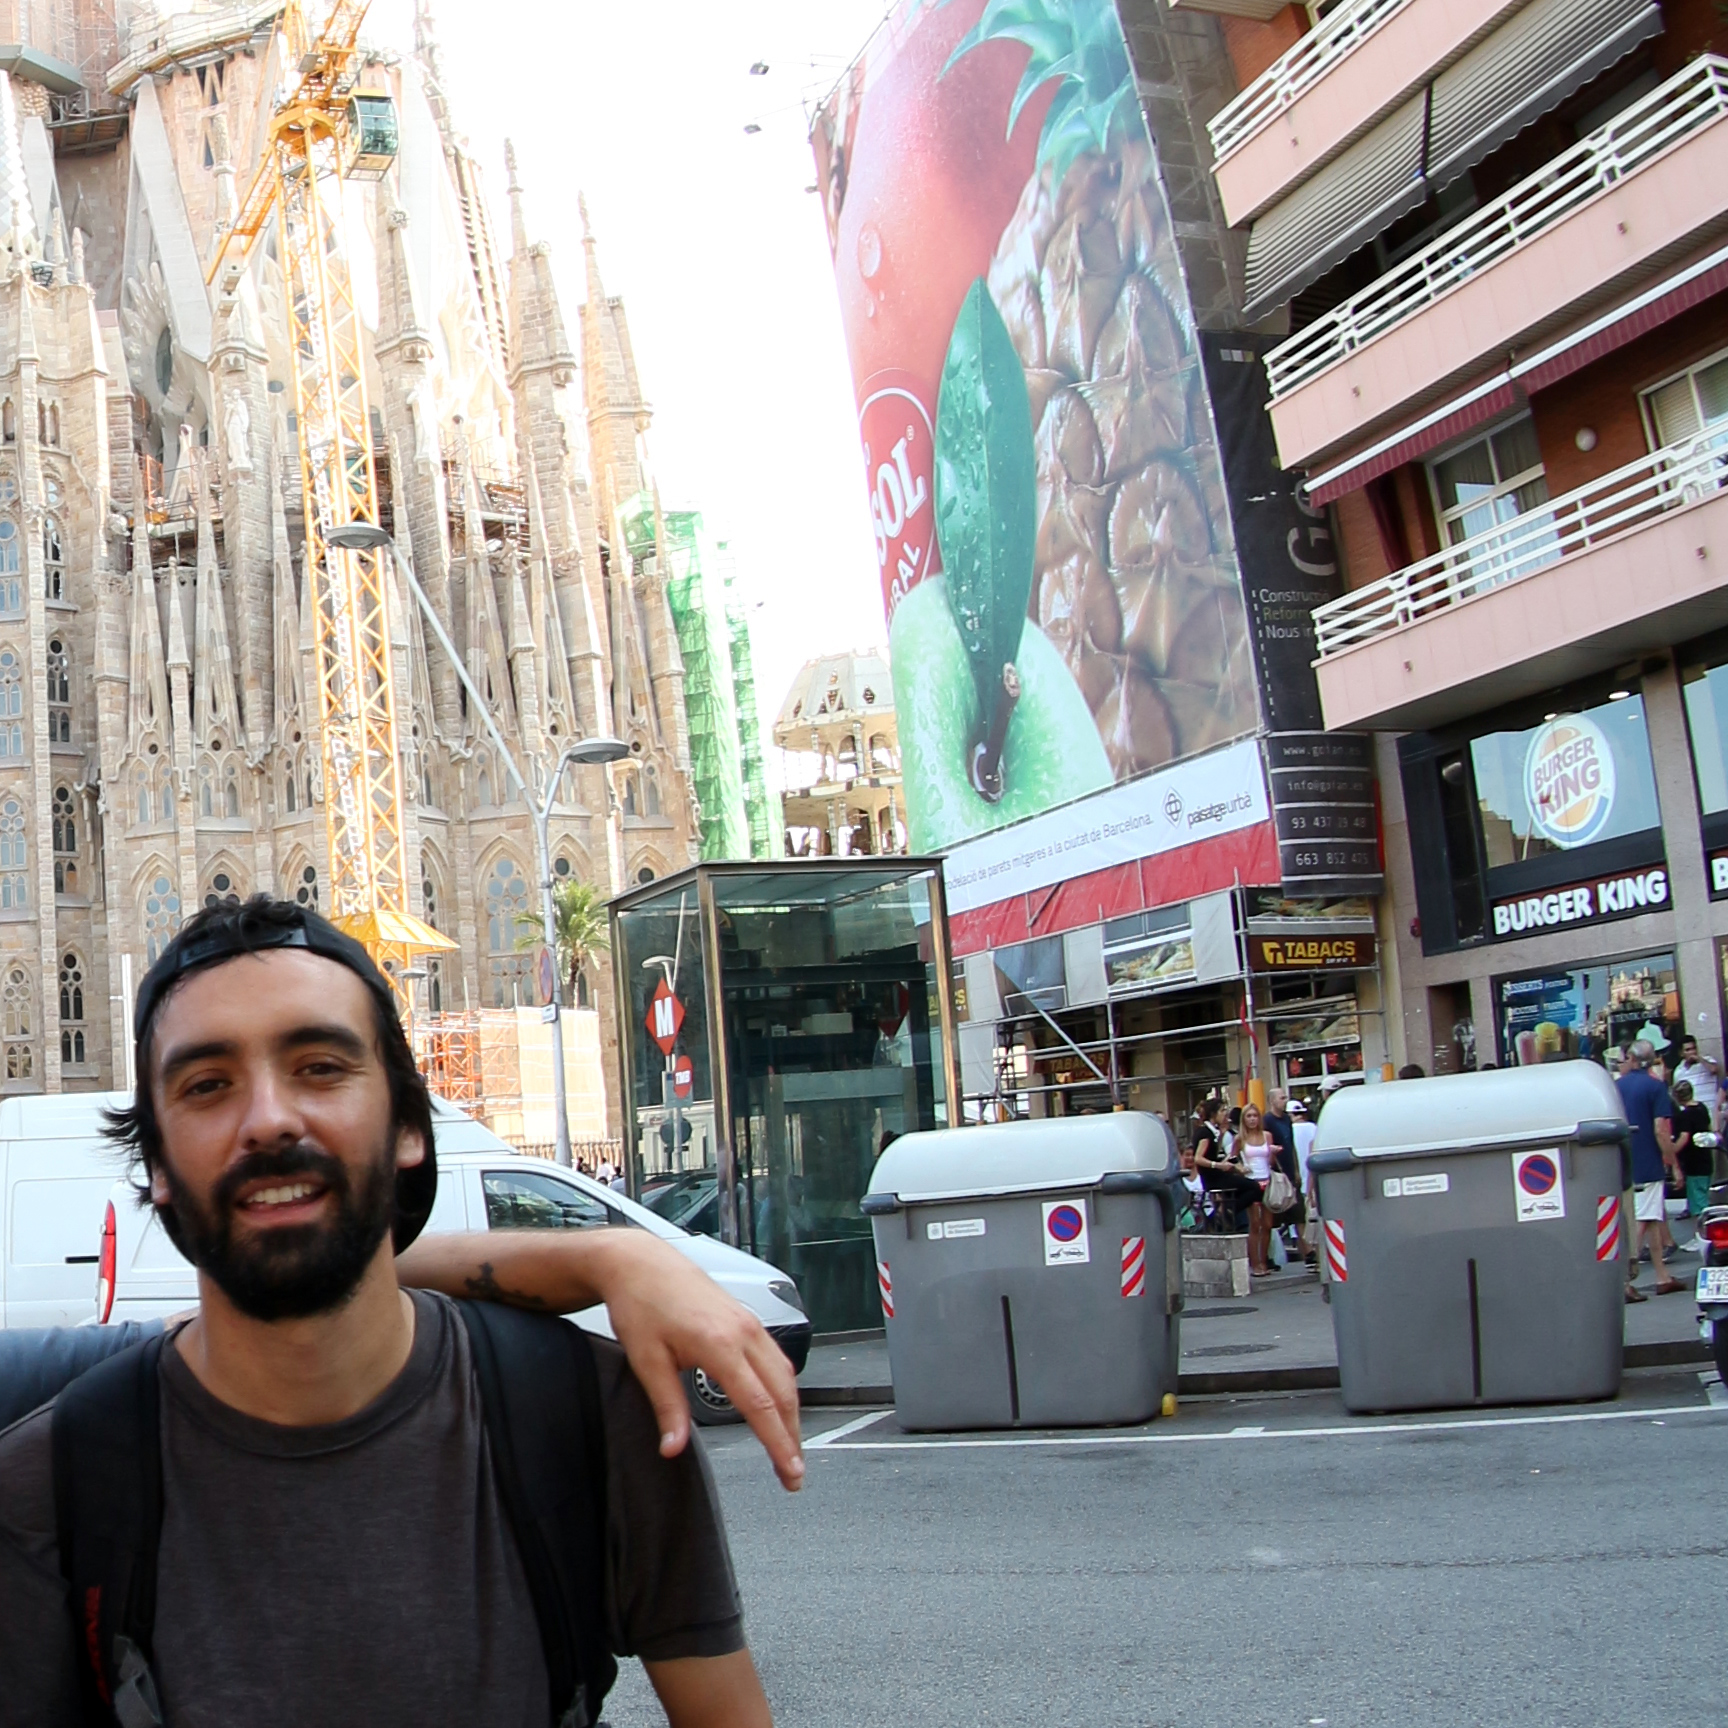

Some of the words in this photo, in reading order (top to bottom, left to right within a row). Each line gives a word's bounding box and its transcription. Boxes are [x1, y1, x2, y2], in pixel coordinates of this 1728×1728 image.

[1264, 624, 1300, 639] Nous
[1534, 736, 1595, 792] BURGER
[1538, 758, 1601, 823] KING
[1295, 853, 1319, 866] 663
[1493, 887, 1593, 935] BURGER
[1597, 870, 1668, 914] KING
[1284, 940, 1356, 959] TABACS
[654, 996, 675, 1039] M
